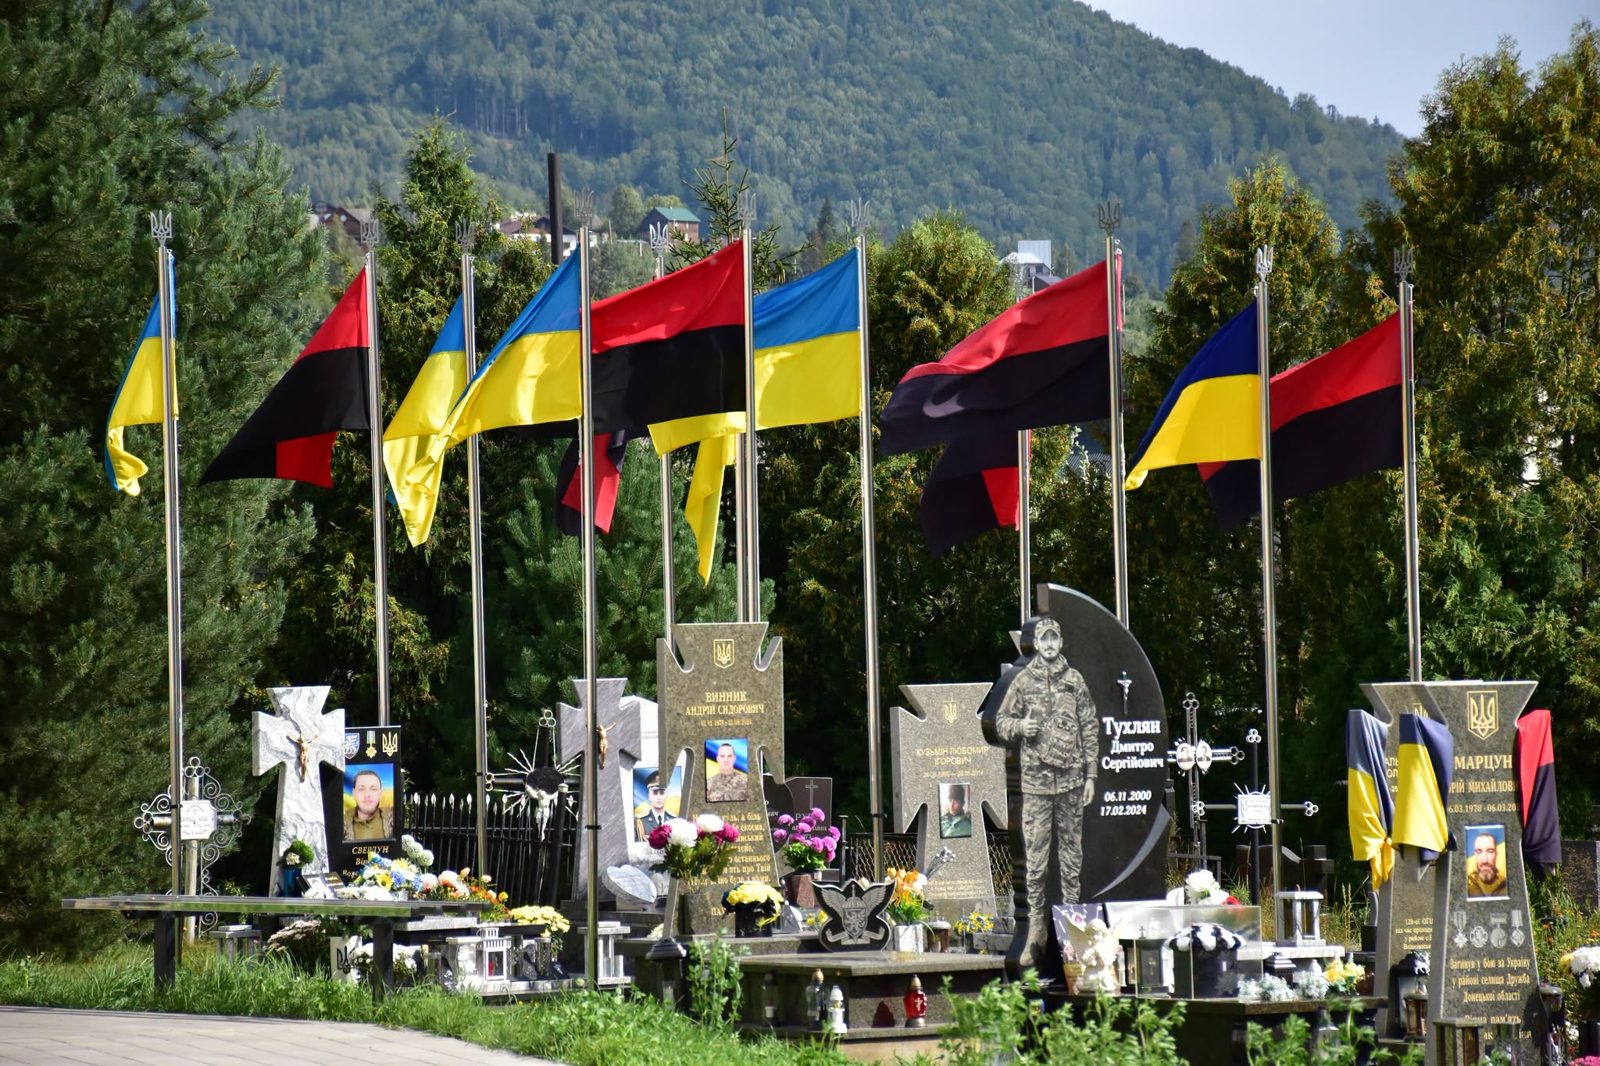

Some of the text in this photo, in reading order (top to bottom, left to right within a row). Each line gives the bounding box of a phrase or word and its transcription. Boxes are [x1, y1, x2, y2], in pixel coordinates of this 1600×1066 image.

[705, 691, 747, 702] ВИННИК
[685, 704, 765, 716] АНДРІЙ СИДОРОВИЧ
[1102, 716, 1161, 740] Тухлян
[1110, 740, 1155, 756] Дмитро
[1102, 756, 1164, 773] Сергійович
[1454, 755, 1513, 771] МАРЦУН
[1449, 779, 1465, 794] РІЙ
[1104, 790, 1152, 802] 06.11.2000
[1100, 804, 1147, 816] 17.02.2024
[1448, 804, 1481, 814] 6.03.1978
[1506, 956, 1531, 970] Україну
[1458, 973, 1479, 988] районі
[1481, 975, 1505, 985] селища
[1506, 972, 1531, 987] Дружба
[1463, 989, 1521, 1004] Донецької області
